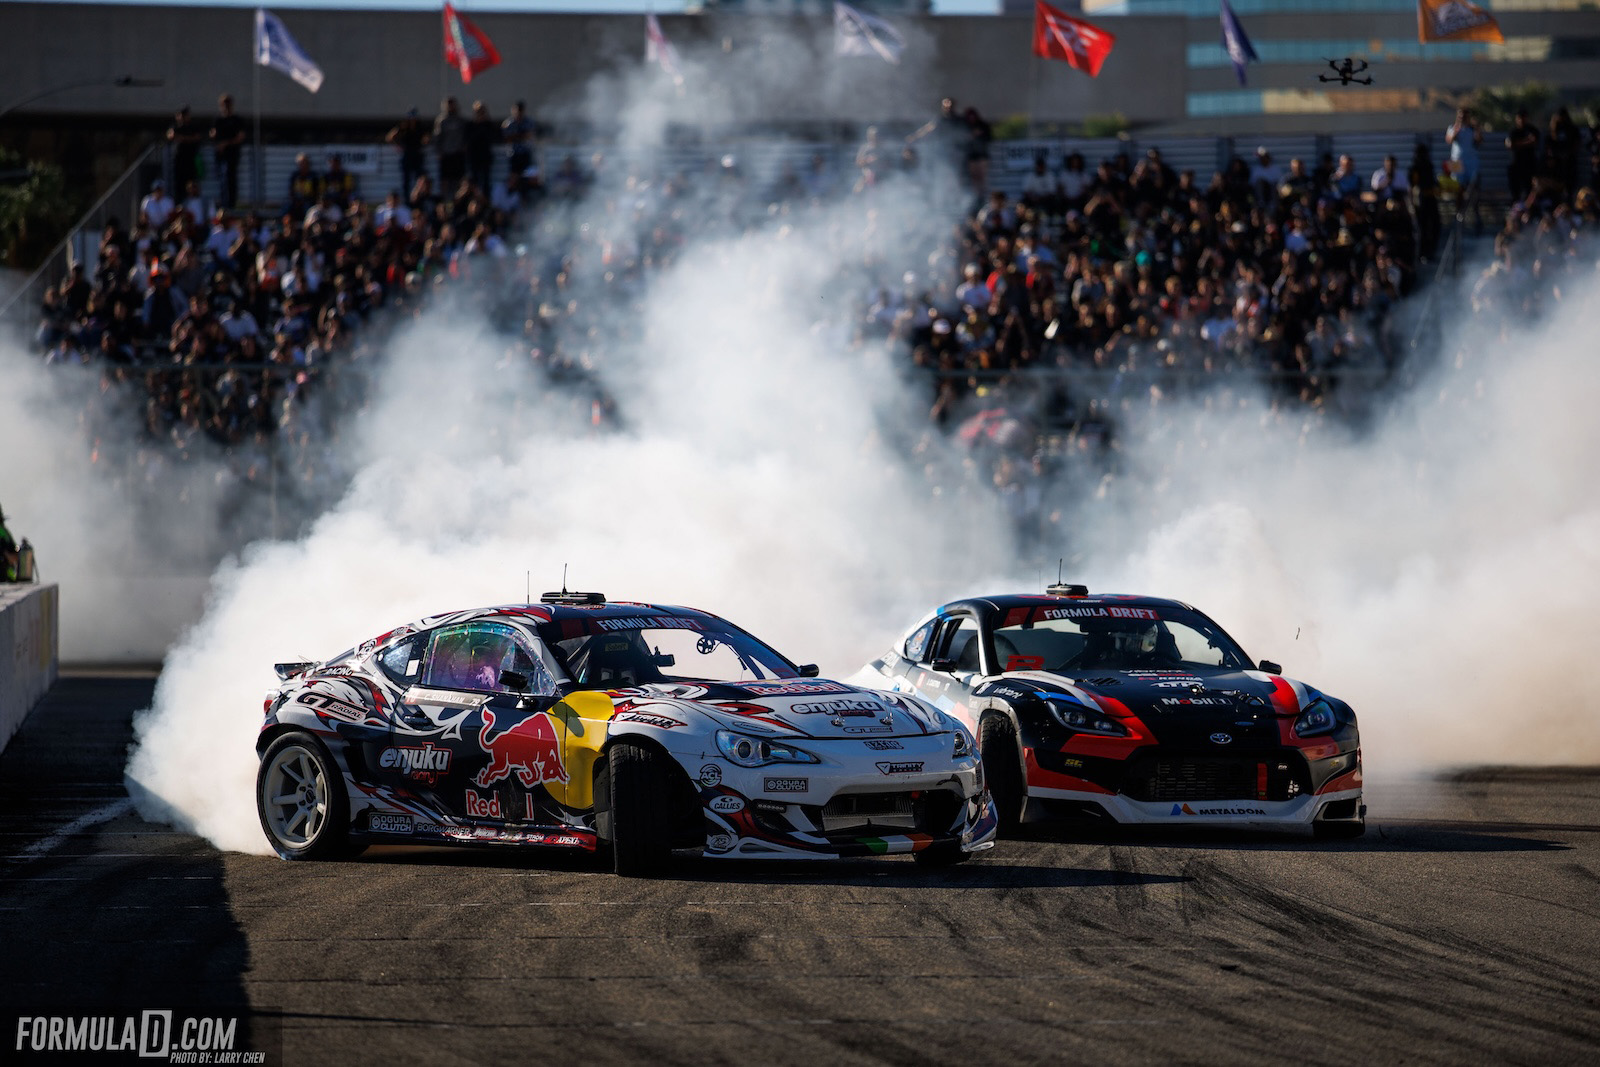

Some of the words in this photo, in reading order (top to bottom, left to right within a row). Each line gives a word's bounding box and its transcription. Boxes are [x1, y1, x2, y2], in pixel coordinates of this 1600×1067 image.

[1044, 607, 1108, 620] FORMULA
[1109, 606, 1155, 620] DRIFT
[597, 618, 660, 631] FORMULA
[657, 617, 703, 630] DRIFT
[794, 701, 880, 715] enjuku
[1161, 697, 1214, 706] Mobil
[380, 744, 450, 775] enjuku
[701, 771, 722, 780] ACL
[465, 789, 501, 818] Red
[1199, 808, 1266, 816] METALDOM
[380, 815, 412, 824] OGURA
[380, 823, 412, 832] CLUTCH
[417, 823, 471, 836] BORGWARNER
